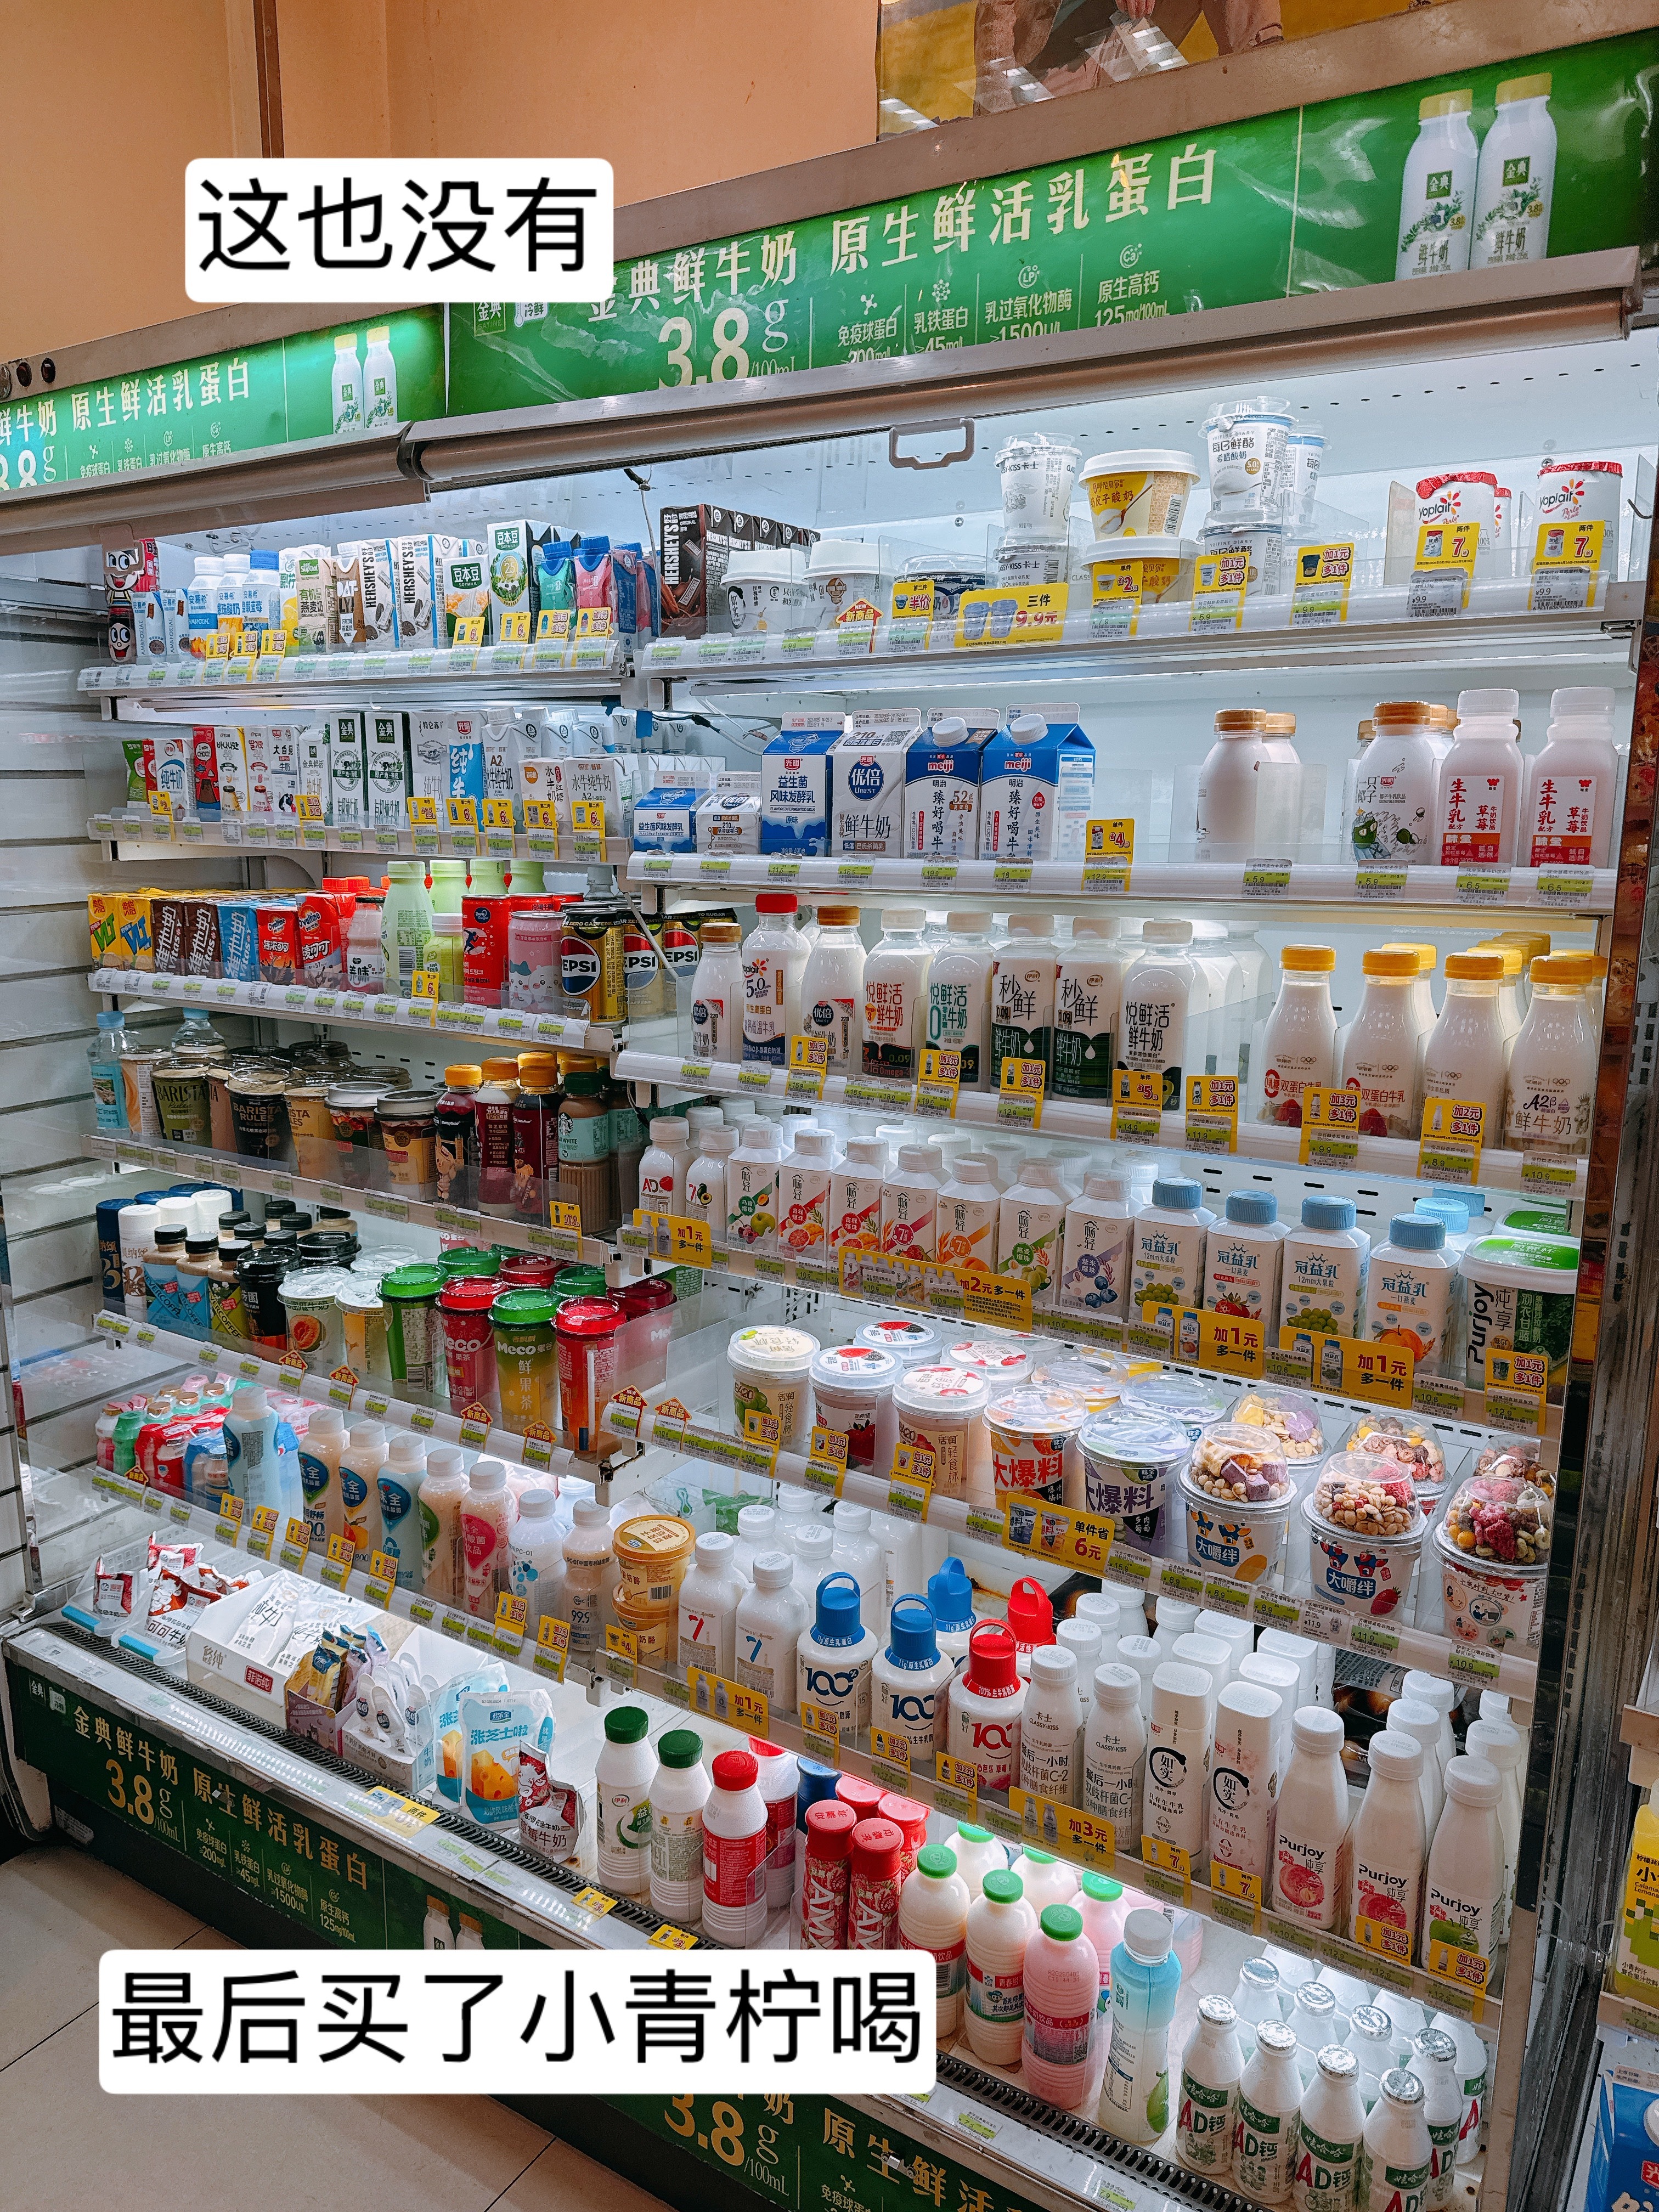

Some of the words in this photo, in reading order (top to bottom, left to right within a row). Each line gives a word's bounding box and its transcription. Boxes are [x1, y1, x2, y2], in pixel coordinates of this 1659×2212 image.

[1505, 161, 1529, 178] 金典
[1428, 175, 1451, 193] 金典
[830, 143, 1217, 276] 原生鲜活乳蛋白
[1098, 270, 1160, 304] 原生高钙
[985, 288, 1072, 324] 乳过氧化物酶
[914, 307, 968, 334] 乳铁蛋白
[837, 315, 898, 347] 免疫球蛋白
[658, 309, 749, 387] 3.8
[71, 357, 250, 433] 原生鲜活乳蛋白
[1212, 436, 1254, 453] 每日鲜酪
[1419, 501, 1451, 522] yoplait
[1539, 492, 1573, 512] yoplait
[496, 531, 518, 545] 豆本豆
[664, 525, 679, 585] HERSHEY'S
[1219, 556, 1245, 570] 加1元
[1323, 549, 1350, 561] 加1元
[454, 567, 479, 583] 豆本豆
[1218, 572, 1243, 586] 多1件
[1322, 562, 1348, 577] 多1件
[301, 601, 323, 613] 燕麦奶
[910, 594, 930, 611] 半价
[1028, 595, 1050, 606] 三件
[845, 610, 874, 621] 新商品
[1015, 610, 1057, 627] 9.9元
[341, 722, 353, 736] 金典
[378, 723, 393, 737] 金典
[217, 742, 239, 751] 바나나맛
[273, 745, 293, 755] 大白兔
[928, 760, 953, 773] meiji
[1005, 758, 1031, 772] meiji
[160, 770, 182, 790] 纯牛奶
[572, 774, 611, 792] 水牛纯牛奶
[778, 776, 808, 788] 益生菌
[851, 768, 880, 786] 优倍
[933, 780, 946, 788] 明治
[1009, 779, 1023, 787] 明治
[770, 791, 815, 804] 风味发酵乳
[1448, 779, 1466, 823] 生牛乳
[1538, 780, 1555, 825] 生牛乳
[639, 822, 684, 832] 益生菌风味发酵乳
[845, 814, 890, 839] 鲜牛奶
[1476, 805, 1489, 830] 草莓
[1566, 806, 1579, 832] 草莓
[746, 978, 765, 997] 5.0
[866, 982, 902, 1004] 悦鲜活
[930, 983, 967, 1007] 悦鲜活
[814, 1007, 832, 1018] 优倍
[877, 1007, 903, 1026] 鲜牛奶
[1126, 1001, 1170, 1028] 悦鲜活
[1128, 1026, 1163, 1051] 鲜牛奶
[1057, 1034, 1081, 1065] 鲜牛奶
[1210, 1080, 1234, 1092] 加1元
[1362, 1087, 1405, 1103] 双蛋白牛乳
[233, 1103, 282, 1114] BARISTA
[1209, 1093, 1233, 1105] 多1件
[1329, 1093, 1358, 1108] 加3元
[240, 1112, 275, 1122] RULES
[1328, 1108, 1356, 1122] 多1件
[1453, 1106, 1482, 1120] 加2元
[1451, 1122, 1479, 1135] 多1件
[1514, 1113, 1571, 1134] 鲜牛奶
[678, 1225, 703, 1241] 加1元
[679, 1240, 704, 1252] 多一件
[1142, 1237, 1177, 1256] 冠益乳
[1218, 1249, 1257, 1269] 冠益乳
[1295, 1259, 1337, 1279] 冠益乳
[960, 1276, 1025, 1300] 加2元多一件
[1383, 1275, 1425, 1297] 冠益乳
[1468, 1282, 1494, 1363] Purjoy
[1214, 1326, 1259, 1349] 加1元
[498, 1342, 535, 1355] Meco
[1216, 1342, 1256, 1363] 多一件
[1358, 1355, 1407, 1376] 加1元
[1514, 1357, 1543, 1373] 加1元
[519, 1359, 532, 1409] 鲜果茶
[1361, 1373, 1404, 1392] 多一件
[1513, 1373, 1542, 1387] 多1件
[620, 1396, 641, 1406] 新商品
[994, 1455, 1062, 1488] 大爆料
[1086, 1481, 1153, 1514] 大爆料
[1074, 1520, 1109, 1541] 单件省
[1075, 1538, 1101, 1561] 6元
[689, 1616, 704, 1640] 7
[747, 1637, 763, 1663] 7
[735, 1694, 764, 1715] 加1元
[736, 1708, 763, 1725] 多一件
[471, 1724, 529, 1745] 涨芝士啦
[1104, 1735, 1120, 1745] 卡士
[74, 1706, 178, 1786] 金典鲜牛奶
[1022, 1745, 1069, 1767] 餐后一小时
[1021, 1762, 1068, 1782] 双歧杆菌C-2
[106, 1758, 154, 1825] 3.8
[193, 1766, 366, 1889] 原生鲜活乳蛋白
[521, 1822, 567, 1847] 草莓牛奶
[1070, 1820, 1107, 1842] 加3元
[196, 1825, 227, 1854] 免疫球蛋白
[1073, 1835, 1106, 1854] 多一件
[1279, 1835, 1325, 1860] Purjoy
[234, 1850, 261, 1874] 乳铁蛋白
[267, 1867, 309, 1903] 乳过氧化物酶
[1359, 1864, 1407, 1888] Purjoy
[1387, 1887, 1407, 1904] 纯享
[1431, 1888, 1480, 1916] Purjoy
[320, 1899, 349, 1925] 原生高钙
[1459, 1915, 1479, 1932] 纯享
[1382, 1926, 1407, 1942] 加1元
[1382, 1938, 1407, 1955] 多1件
[1459, 1952, 1485, 1969] 加1元
[1455, 1966, 1482, 1982] 多1件
[1179, 2100, 1226, 2135] AD钙
[1235, 2122, 1278, 2159] AD钙
[1296, 2153, 1351, 2193] AD钙
